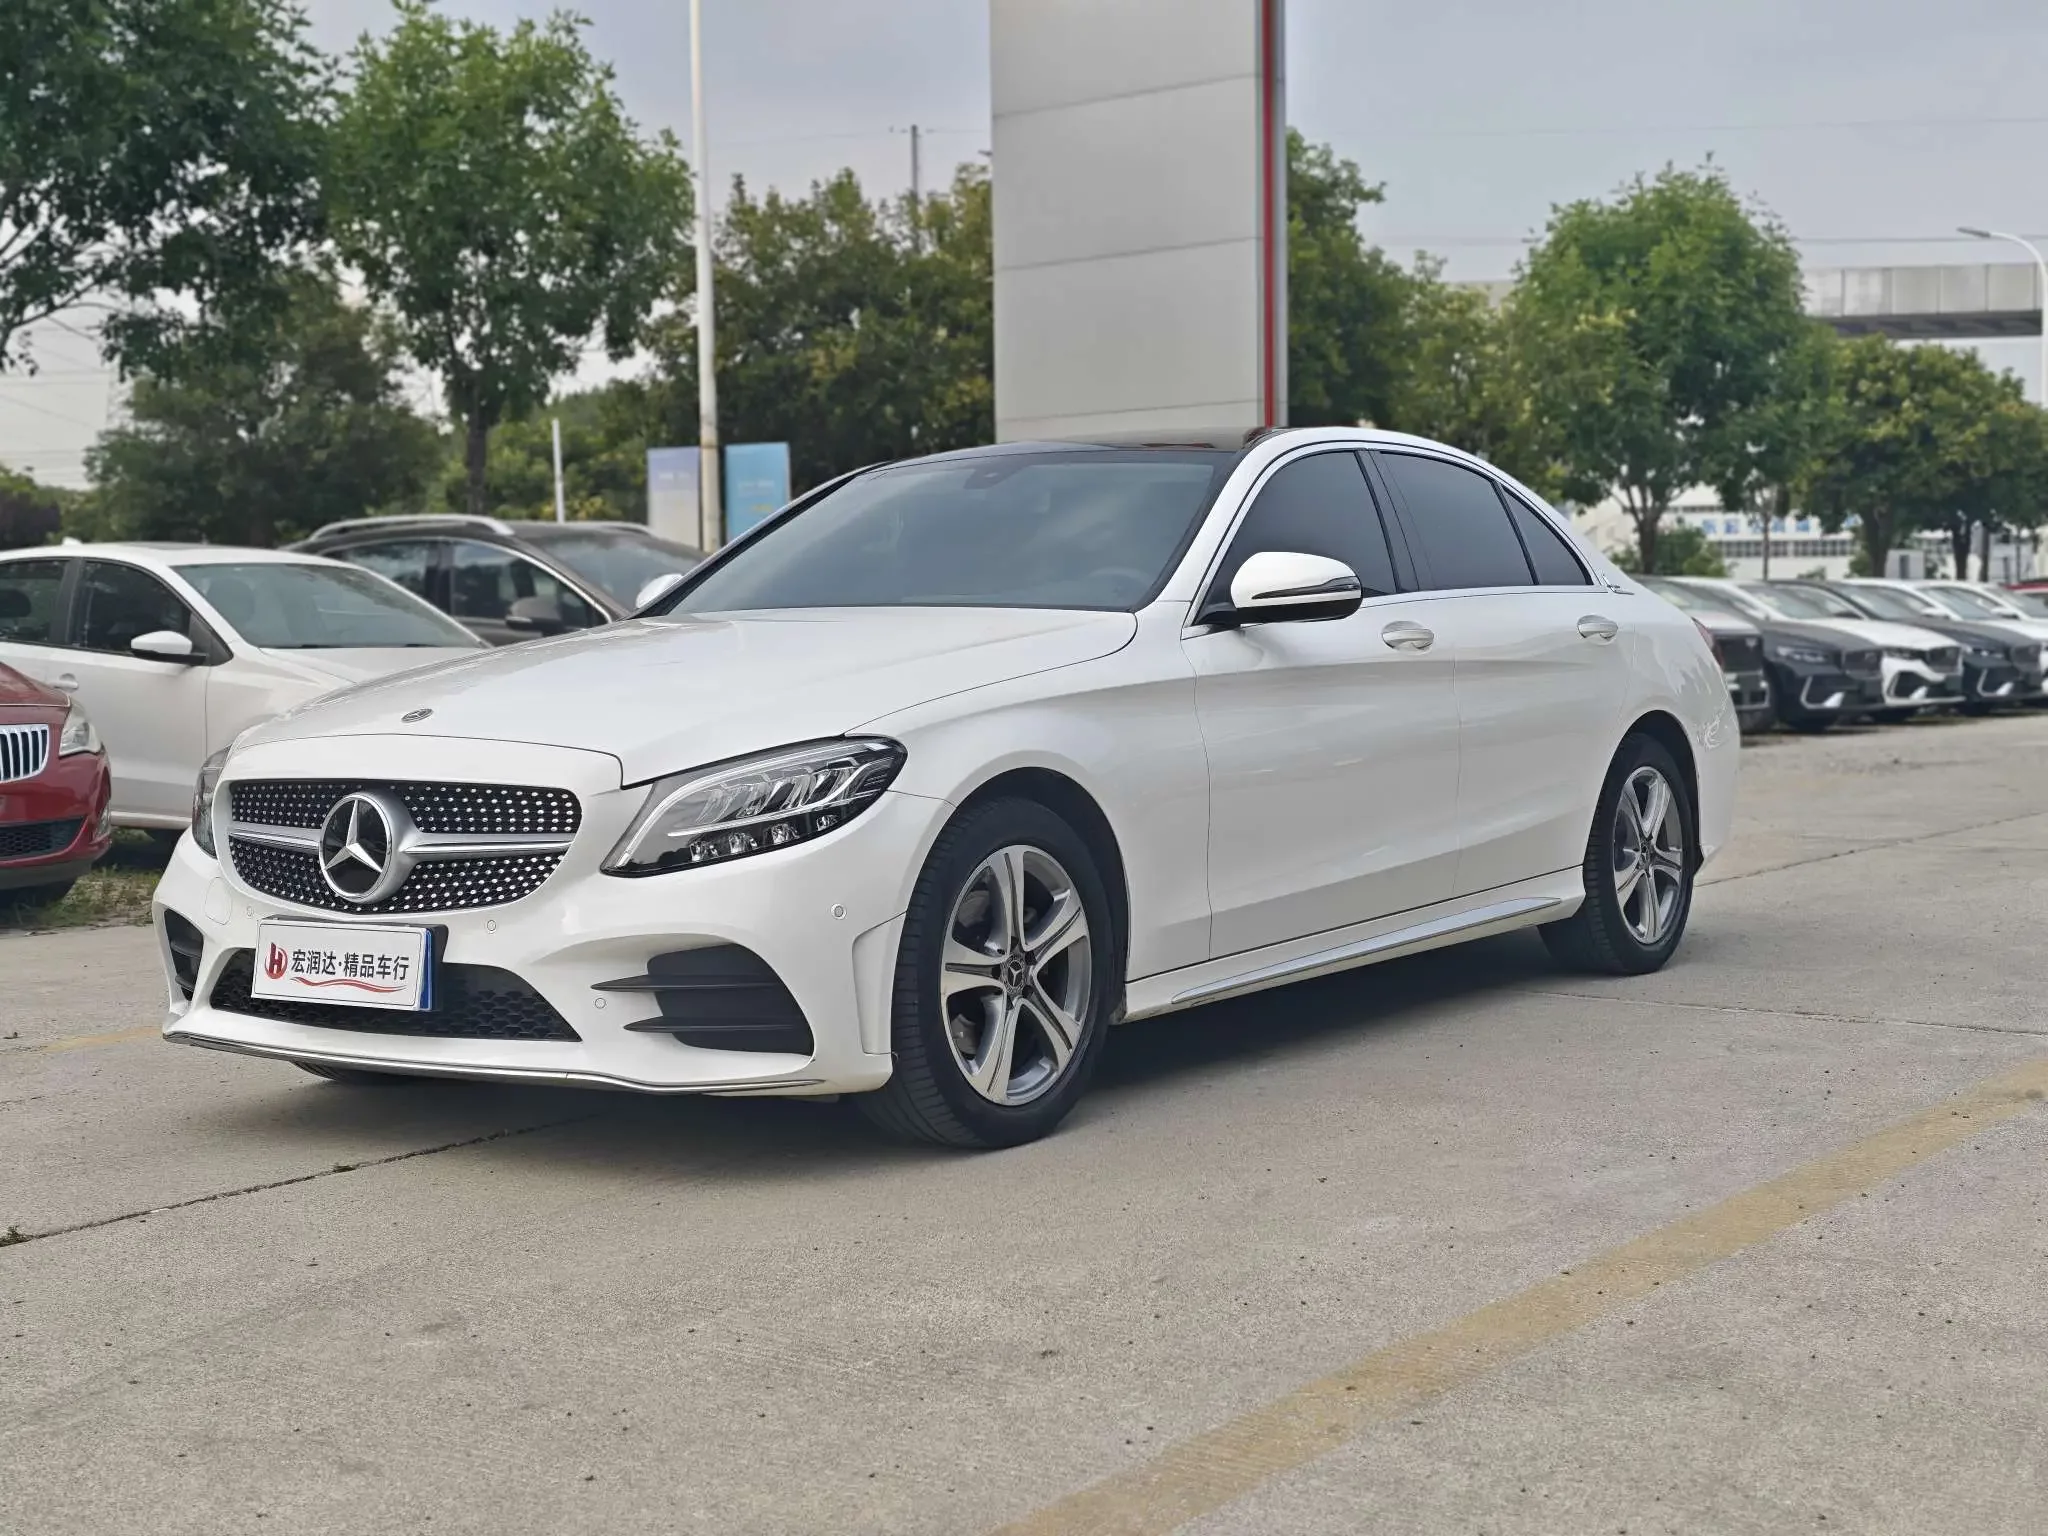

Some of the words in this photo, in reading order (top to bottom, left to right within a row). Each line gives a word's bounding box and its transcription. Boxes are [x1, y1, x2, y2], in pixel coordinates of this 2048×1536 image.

[291, 948, 410, 981] 宏润达·精品车行
